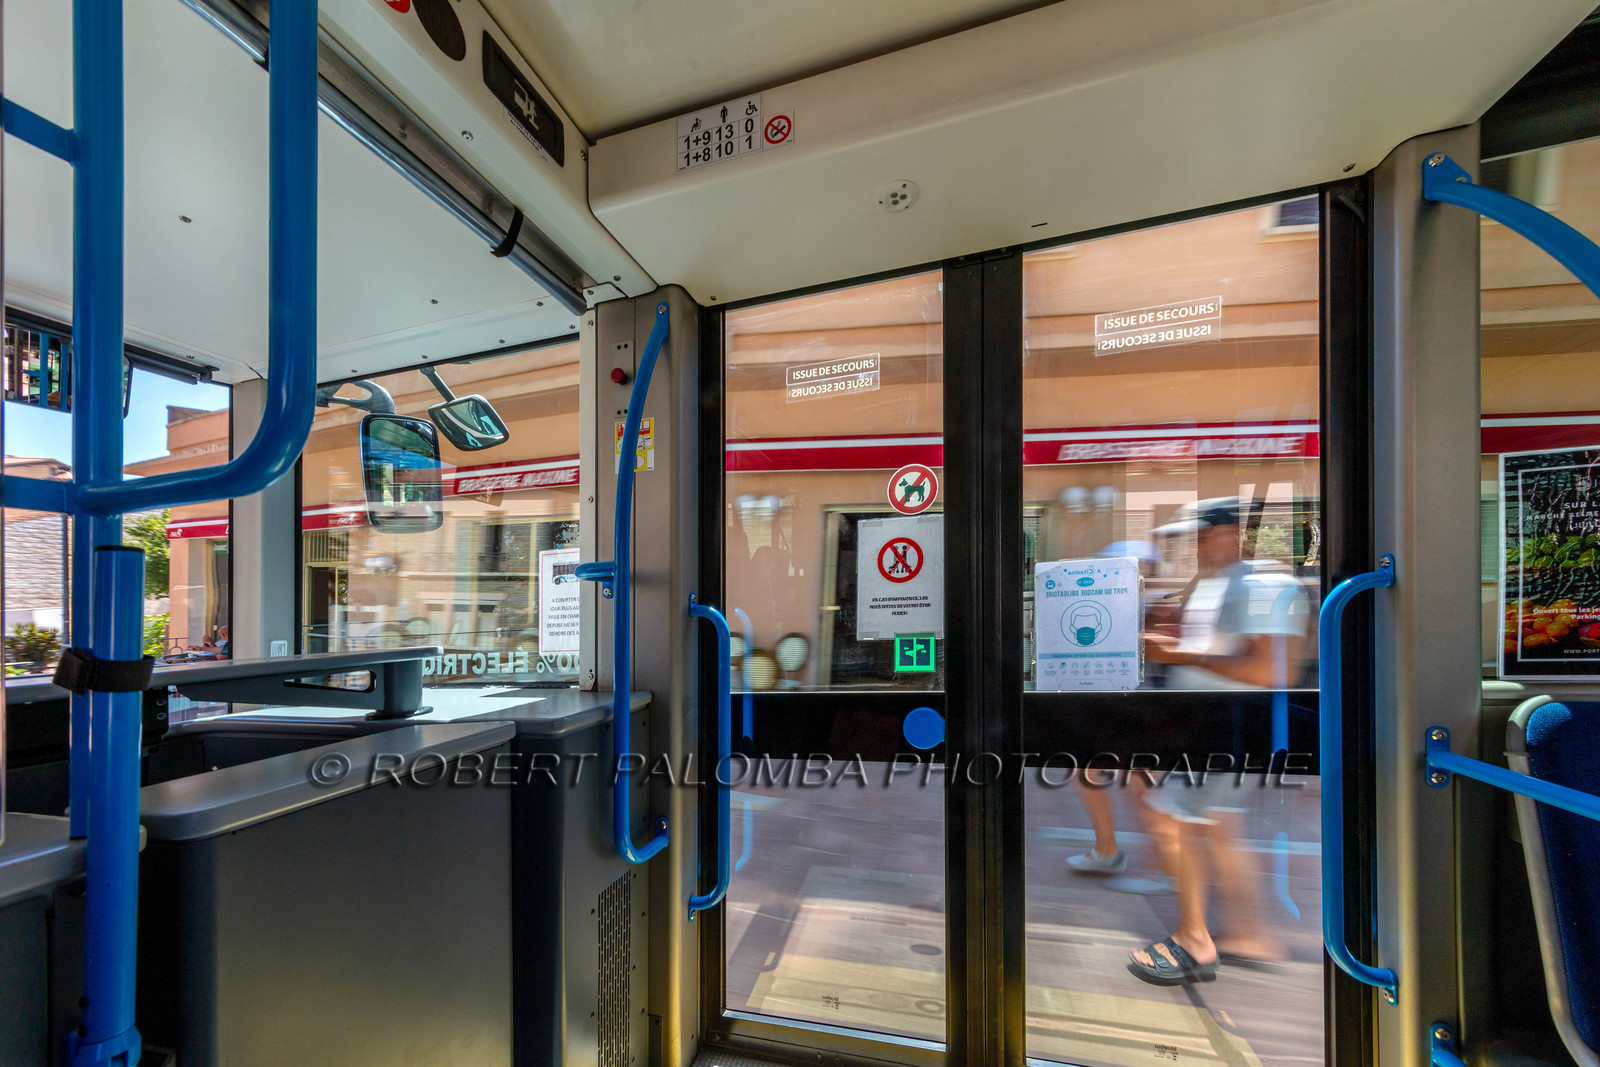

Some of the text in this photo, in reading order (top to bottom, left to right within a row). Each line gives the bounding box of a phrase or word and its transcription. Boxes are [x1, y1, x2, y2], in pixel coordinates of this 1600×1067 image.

[684, 118, 754, 150] 1+9 13 0
[684, 135, 752, 166] 1+8 10 1
[1104, 316, 1137, 330] ISSUE
[1139, 312, 1154, 324] DE
[1156, 303, 1214, 322] SECOURS
[792, 368, 818, 380] ISSUE
[818, 366, 830, 376] DE
[832, 359, 874, 374] SECOURS
